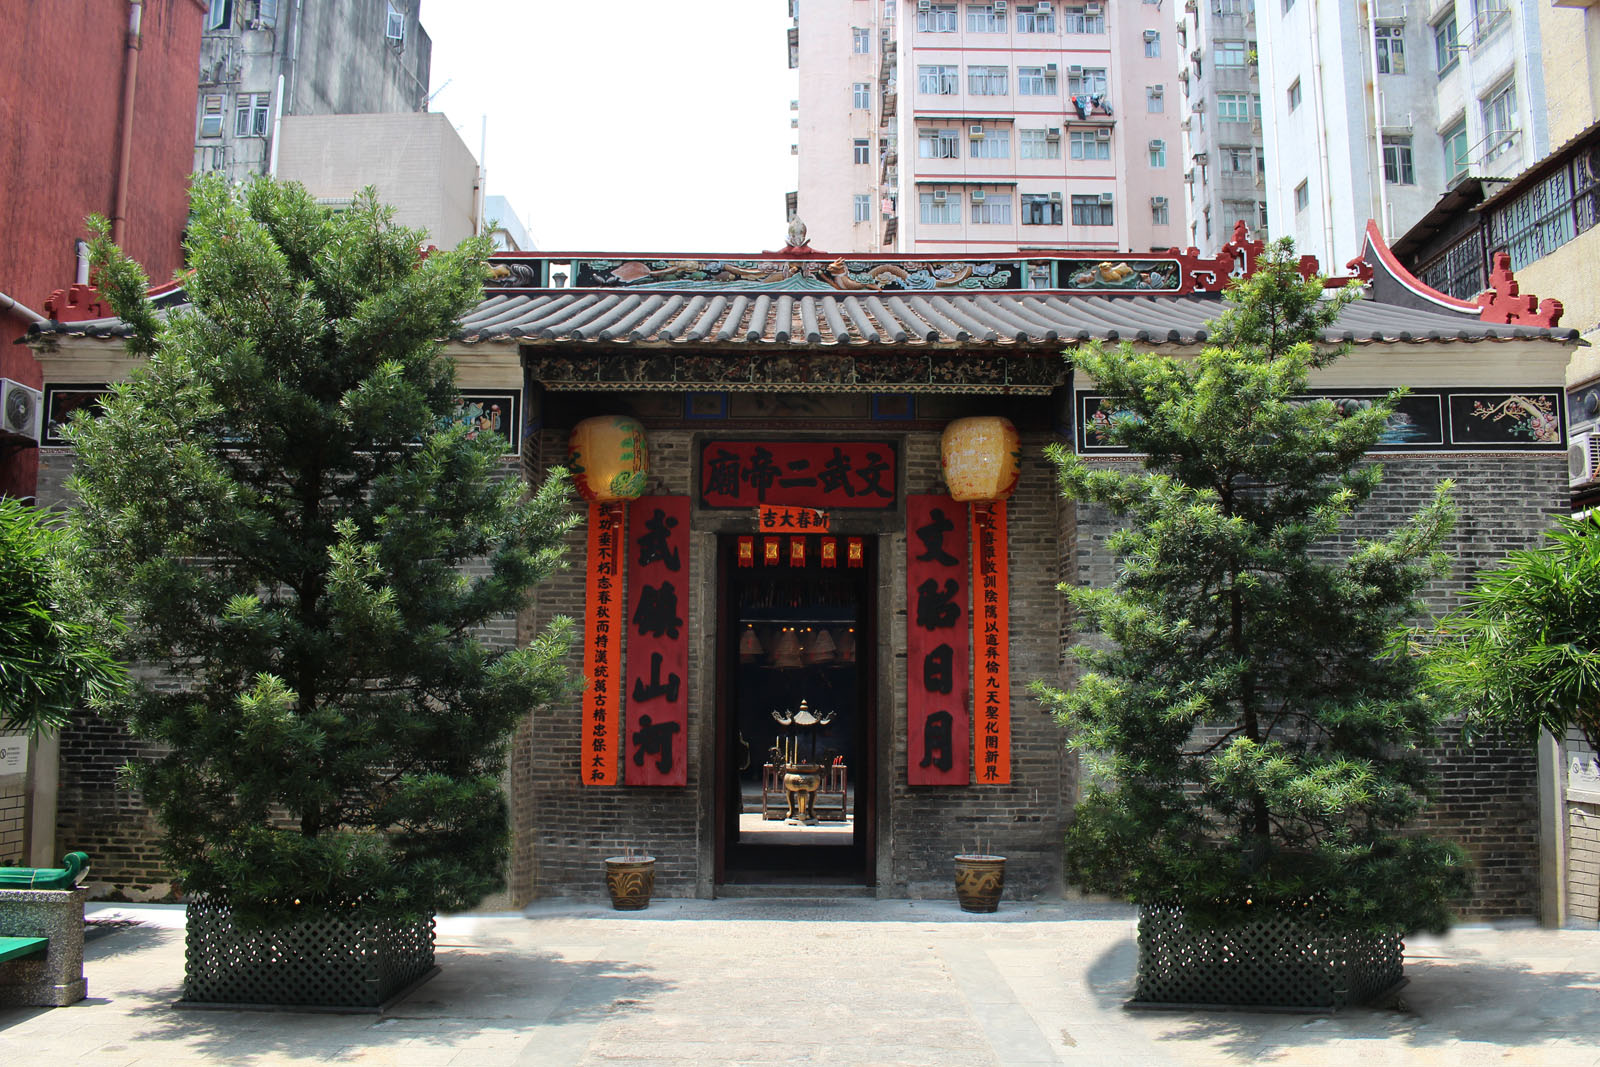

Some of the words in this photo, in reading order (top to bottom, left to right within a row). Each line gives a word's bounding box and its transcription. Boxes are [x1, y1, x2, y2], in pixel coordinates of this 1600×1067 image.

[703, 446, 893, 502] 文武二帝廟
[762, 508, 830, 529] 新春大吉
[632, 507, 684, 775] 武鎮山河
[915, 507, 962, 773] 文昭日月
